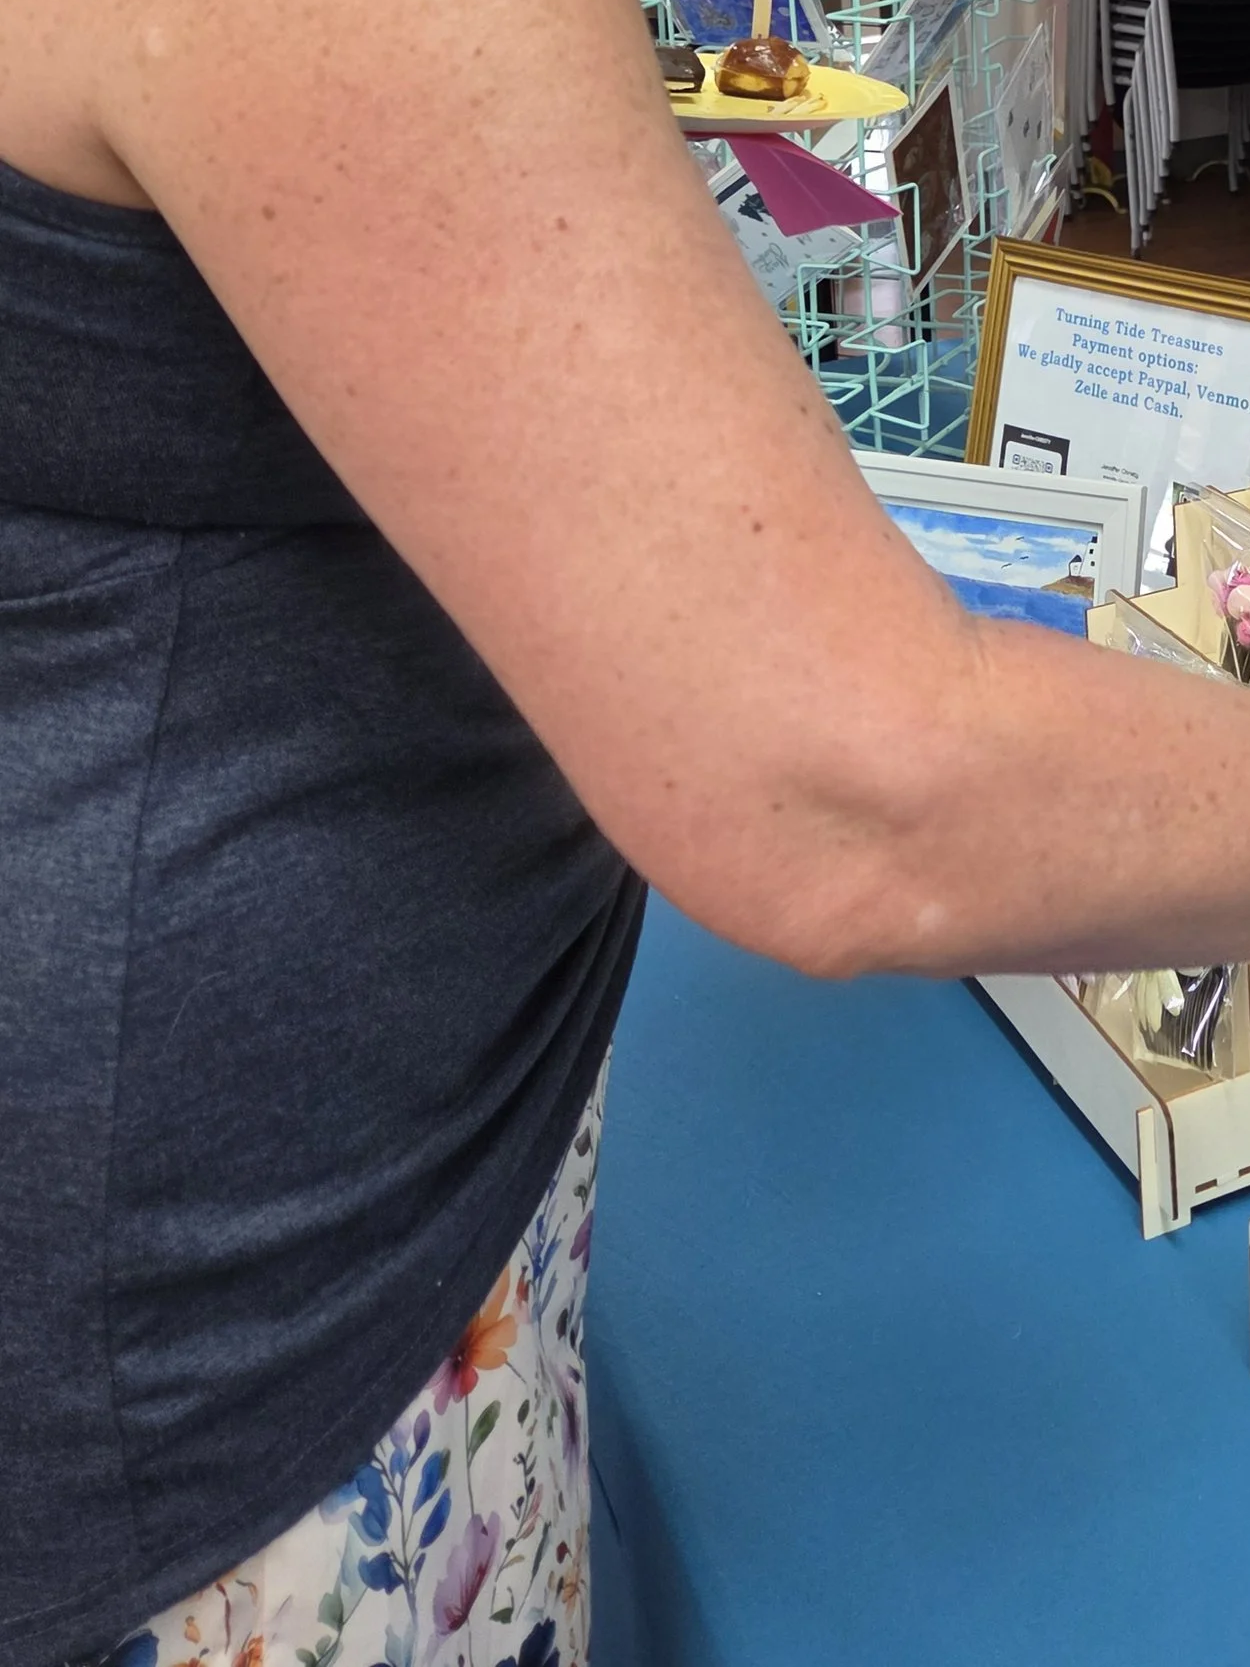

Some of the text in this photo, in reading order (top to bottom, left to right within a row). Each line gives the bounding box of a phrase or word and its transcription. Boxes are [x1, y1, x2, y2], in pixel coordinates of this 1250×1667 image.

[1056, 307, 1224, 356] Turning Tide Treasures
[1072, 333, 1198, 374] Payment options:
[1018, 343, 1037, 360] We
[1041, 350, 1083, 374] gladly
[1087, 363, 1133, 384] accept
[1138, 371, 1190, 399] Paypal,
[1074, 379, 1183, 418] Zelle and Cash.
